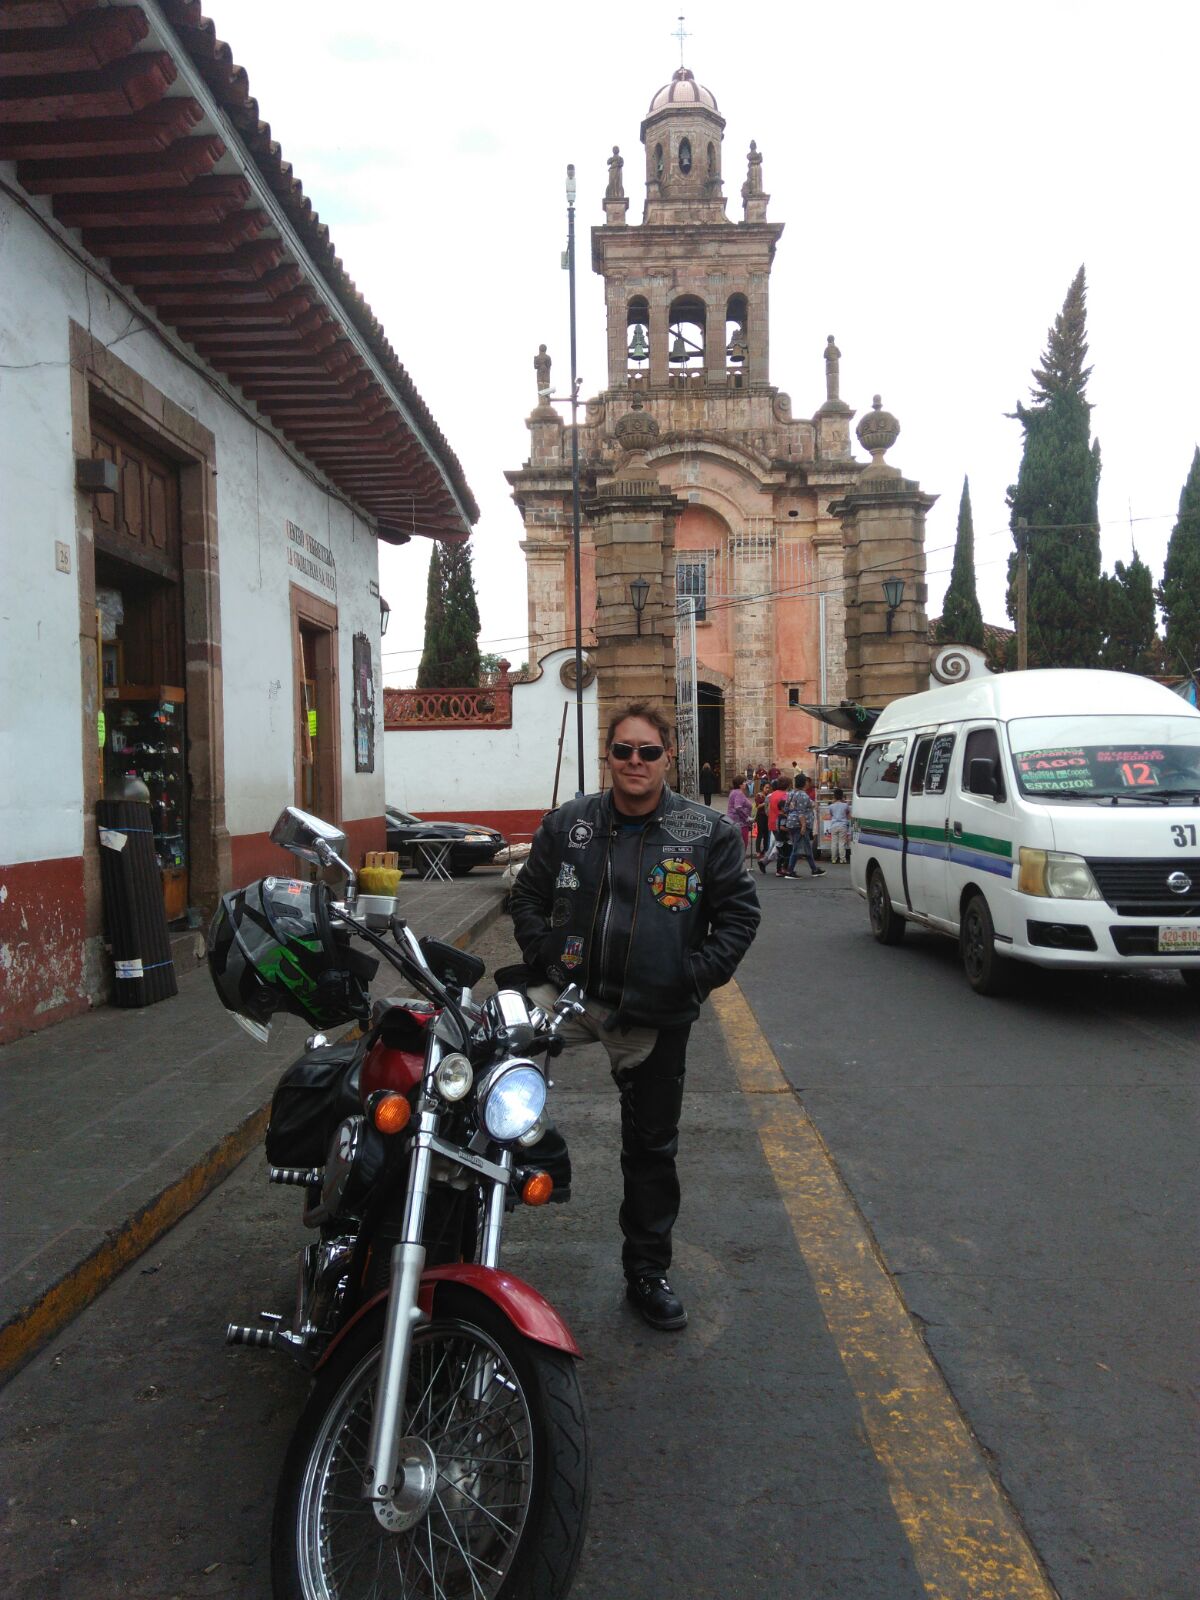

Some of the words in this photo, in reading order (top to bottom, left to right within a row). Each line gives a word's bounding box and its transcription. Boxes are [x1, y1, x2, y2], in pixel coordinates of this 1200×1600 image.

[60, 550, 69, 565] 26
[1122, 762, 1155, 785] 12
[1024, 779, 1094, 790] ESTACION
[1170, 824, 1197, 848] 37
